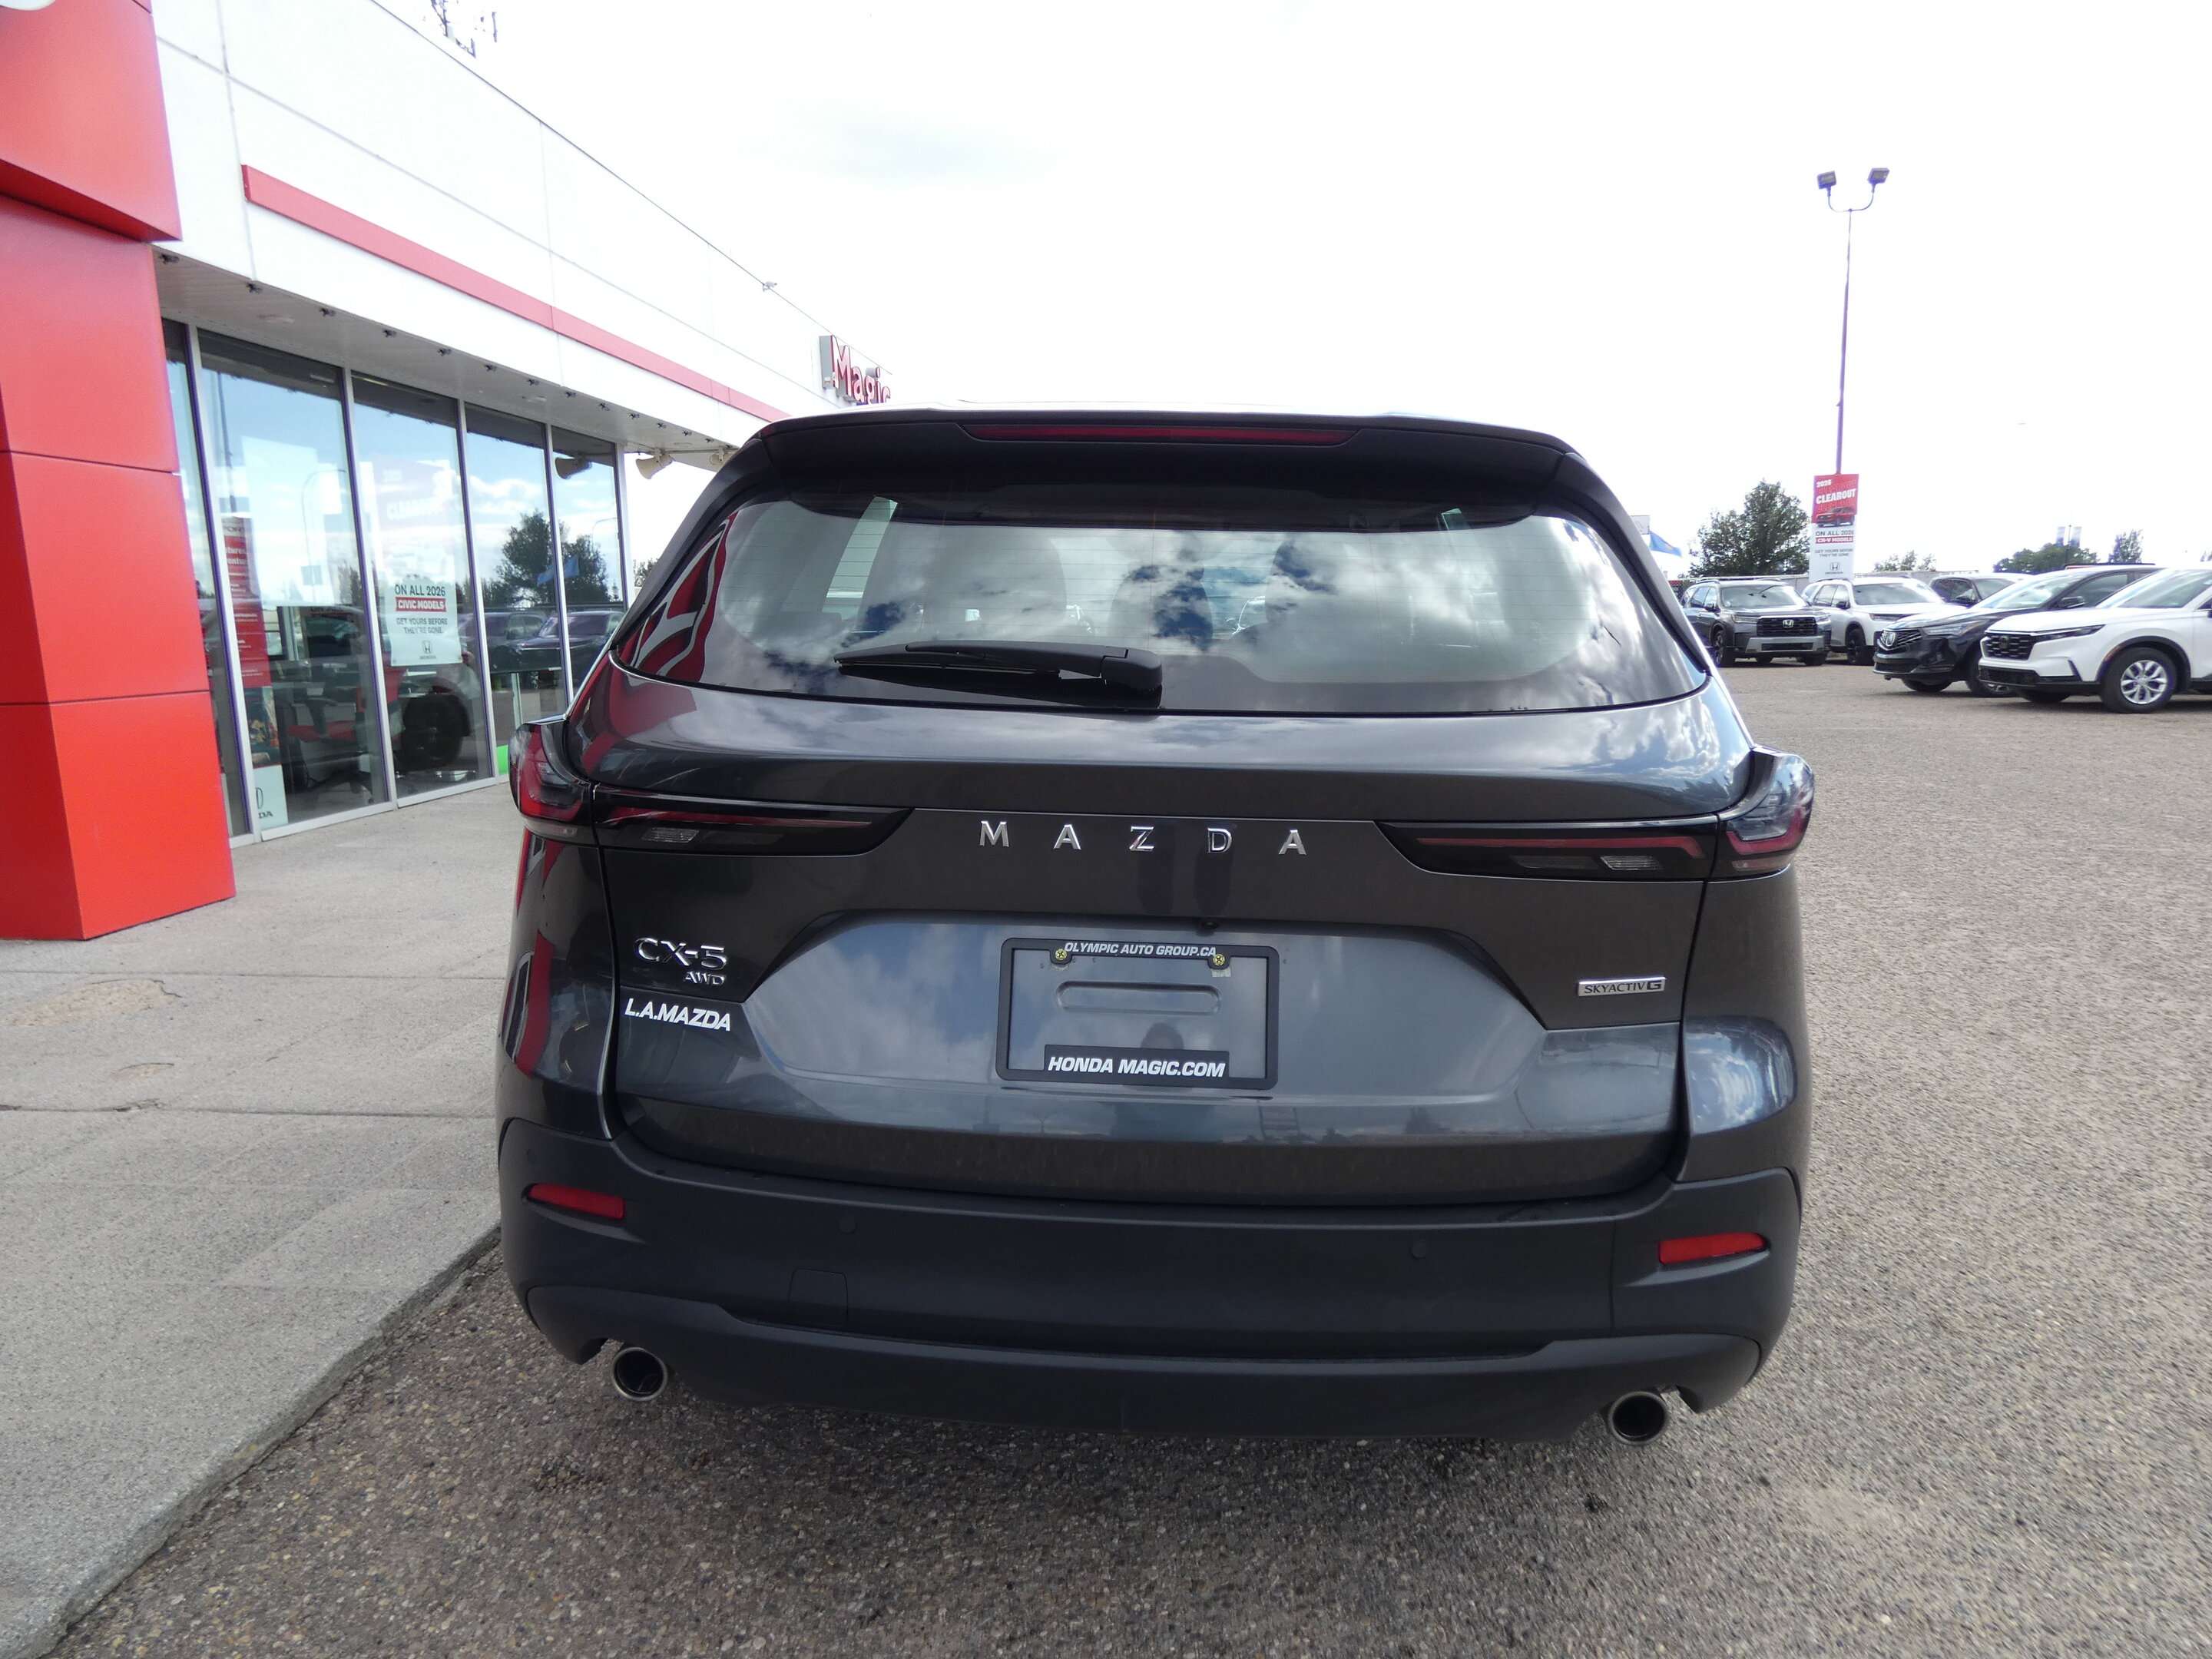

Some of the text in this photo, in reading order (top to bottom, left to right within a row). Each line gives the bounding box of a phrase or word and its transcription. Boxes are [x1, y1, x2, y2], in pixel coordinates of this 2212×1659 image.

[1816, 488, 1856, 505] CLEAROUT
[395, 584, 446, 597] ON ALL 2026
[398, 599, 445, 610] CIVIC MODELS
[979, 821, 1306, 855] MAZDA
[634, 937, 727, 970] CX-5
[1064, 942, 1217, 957] OLYMPIC AUTO GROUP.CA
[683, 971, 726, 985] AWD
[1048, 1056, 1227, 1078] HONDA MAGIC.COM
